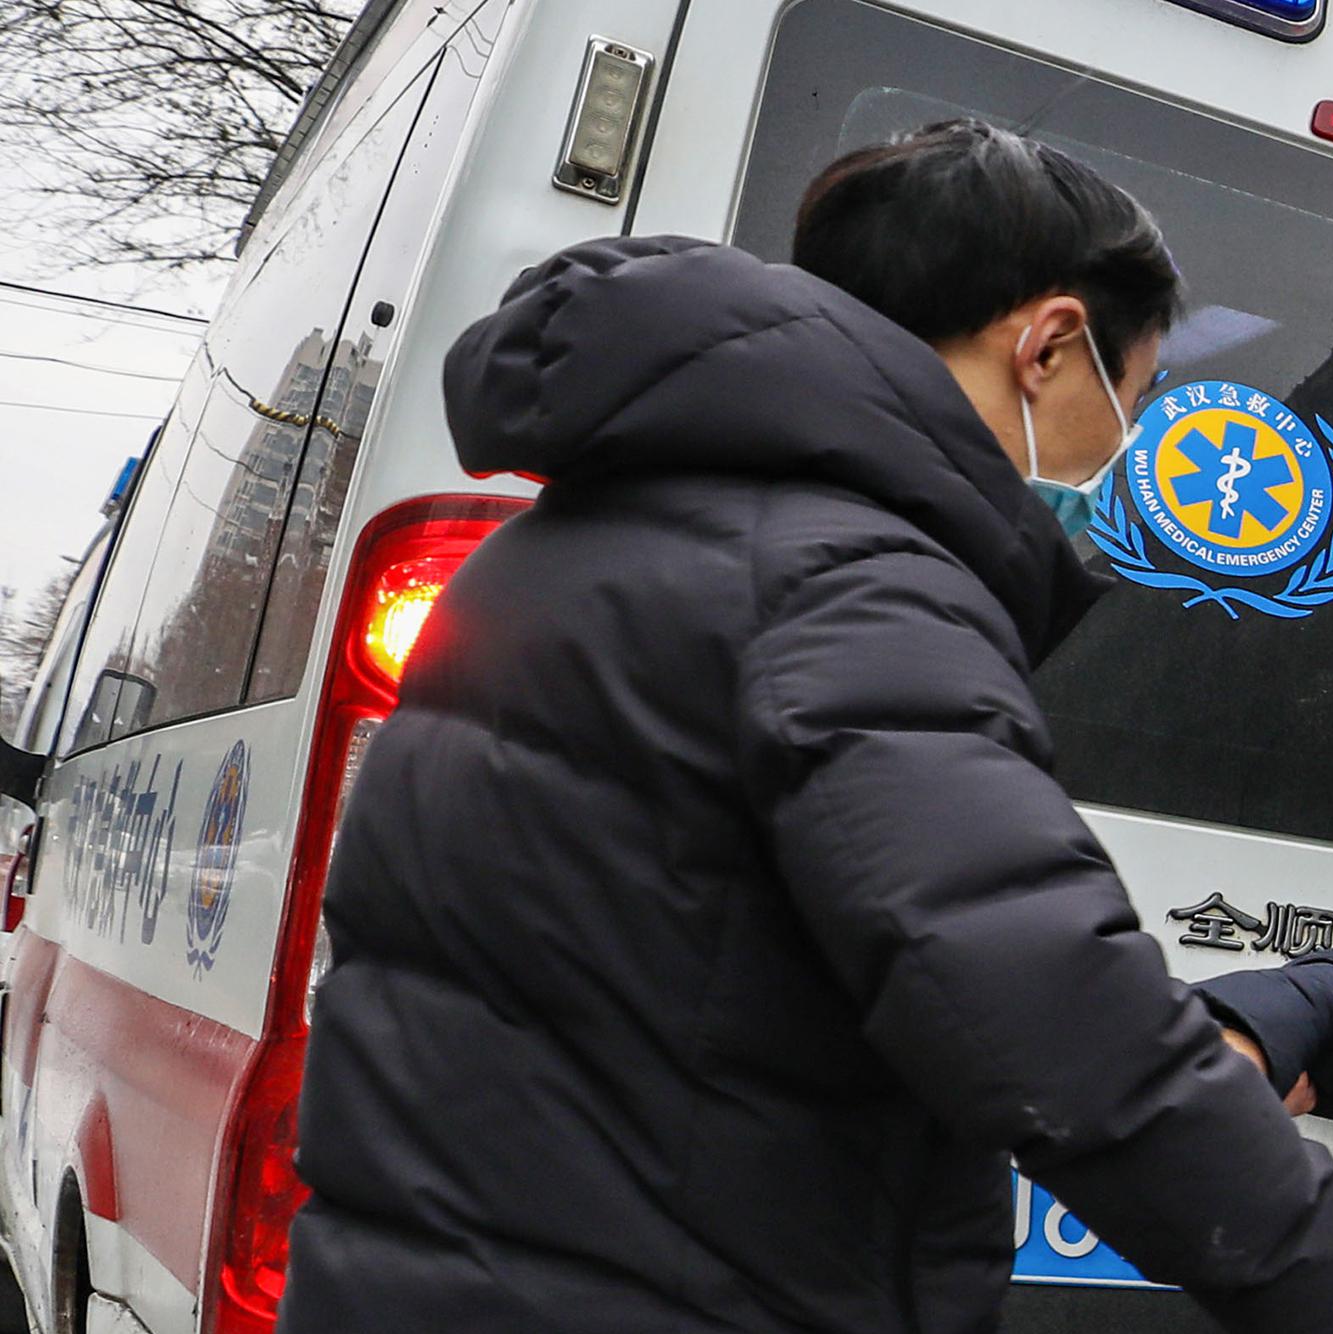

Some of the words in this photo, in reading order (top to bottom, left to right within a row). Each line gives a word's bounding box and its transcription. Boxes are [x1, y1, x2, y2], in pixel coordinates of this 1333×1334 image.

[1160, 384, 1312, 457] 武汉急救中心
[1153, 511, 1215, 563] MEDICAL
[1217, 535, 1300, 566] EMERGENCY
[1298, 489, 1324, 539] CENTER
